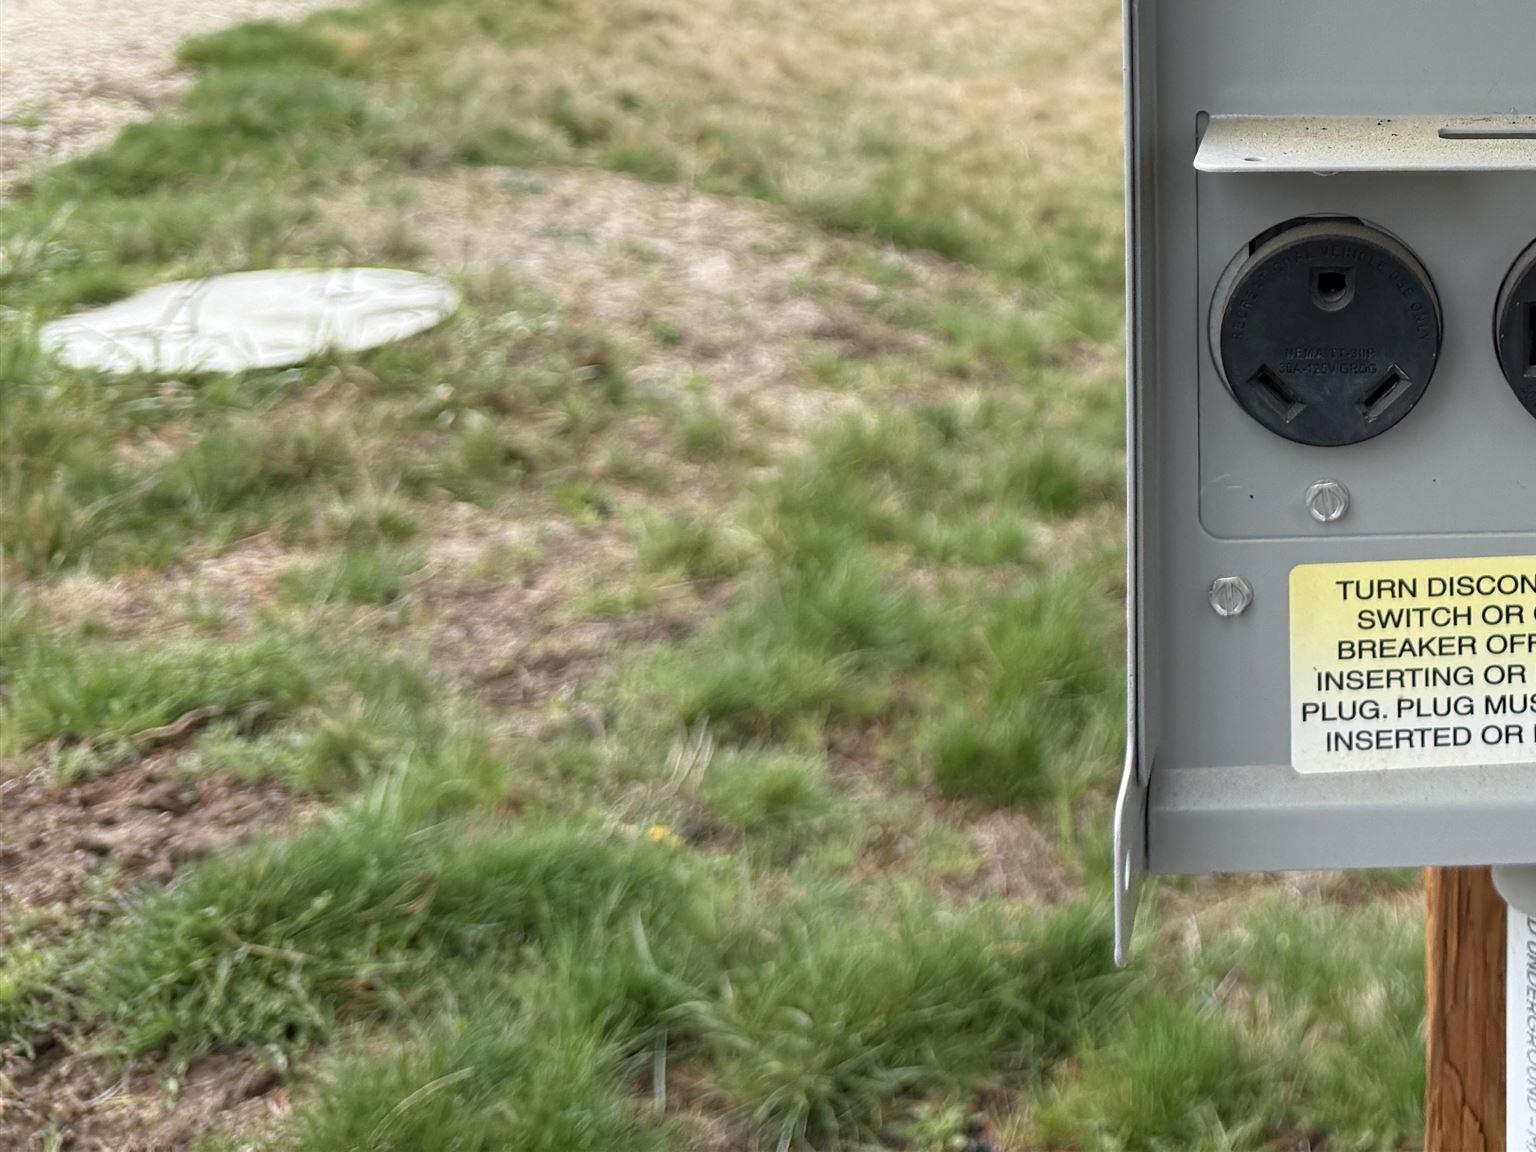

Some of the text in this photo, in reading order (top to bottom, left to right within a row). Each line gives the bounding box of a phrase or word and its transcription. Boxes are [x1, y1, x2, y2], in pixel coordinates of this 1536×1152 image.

[1336, 578, 1418, 601] TURN
[1357, 606, 1473, 630] SWITCH
[1482, 604, 1524, 626] OR
[1338, 635, 1477, 660] BREAKER
[1316, 666, 1474, 692] INSERTING
[1483, 664, 1526, 686] OR
[1302, 700, 1388, 722] PLUG.
[1396, 696, 1474, 718] PLUG
[1326, 726, 1472, 752] INSERTED
[1481, 724, 1524, 745] OR
